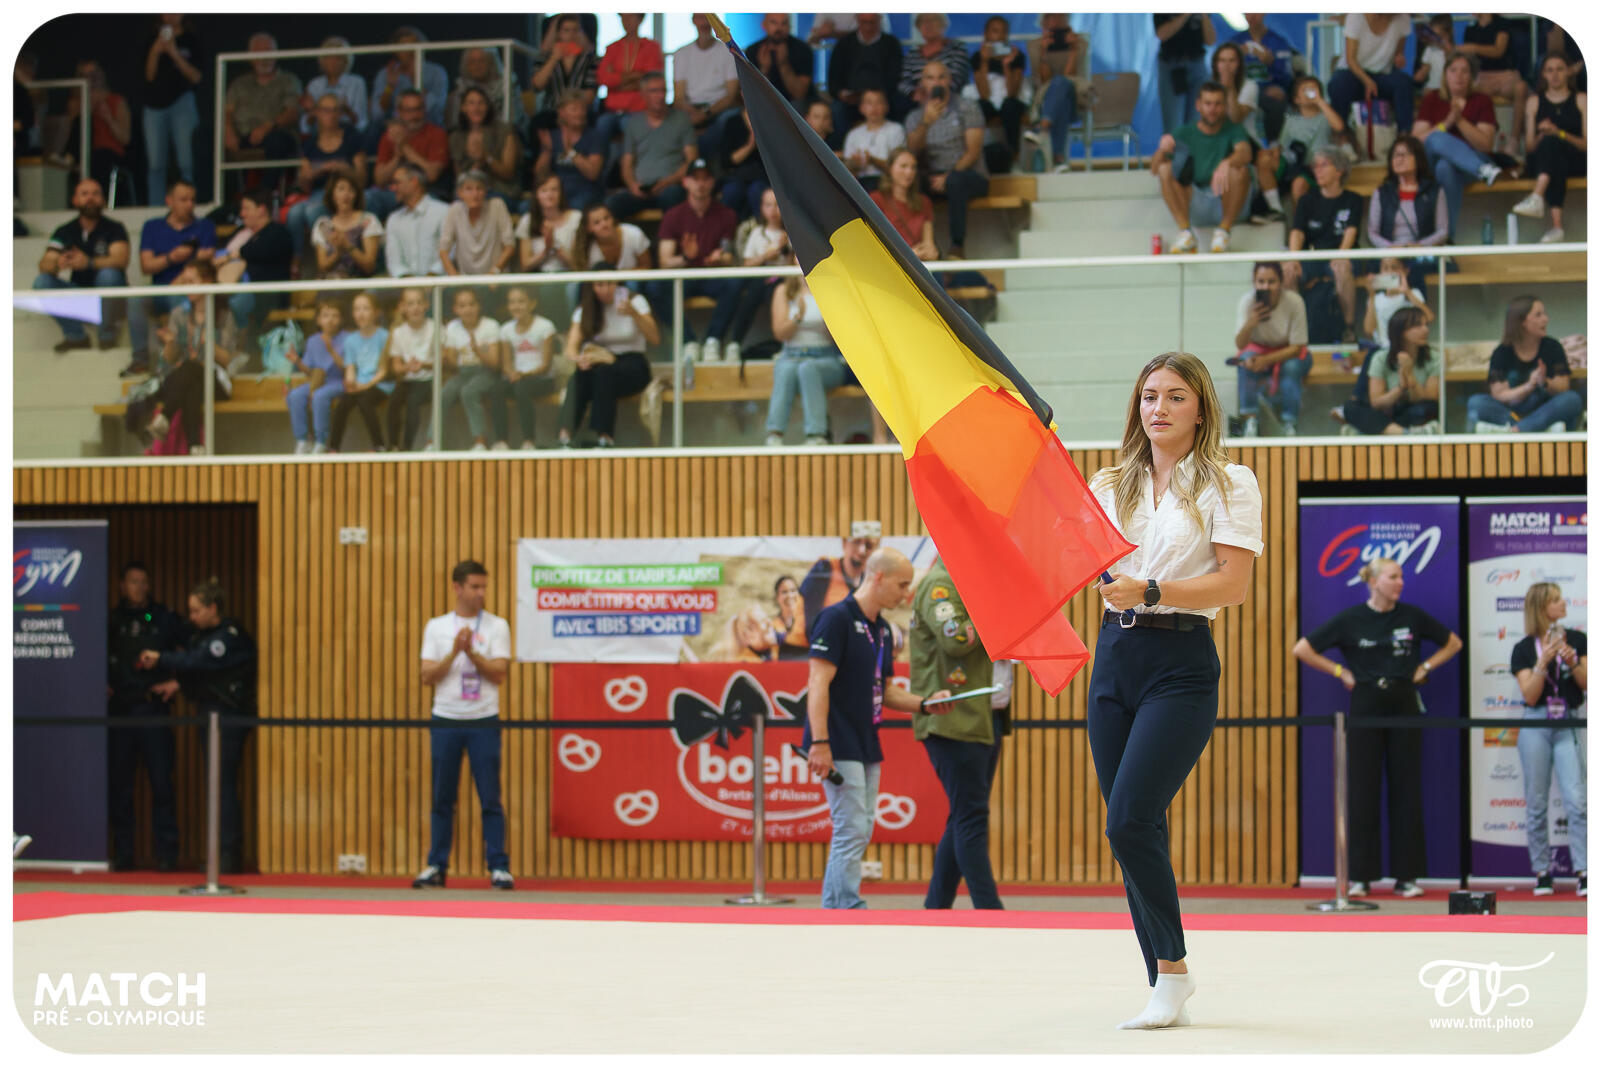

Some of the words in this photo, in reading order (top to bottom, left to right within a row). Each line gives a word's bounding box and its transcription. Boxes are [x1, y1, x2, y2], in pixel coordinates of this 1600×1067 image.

[1490, 512, 1551, 529] MATCH
[534, 569, 603, 585] PROFITEZ
[605, 568, 625, 584] DE
[628, 567, 675, 583] TARIFS
[676, 566, 720, 582] AUSSI
[540, 589, 634, 609] COMPÉTITIFS
[636, 594, 669, 611] QUE
[670, 594, 714, 610] VOUS
[21, 616, 63, 631] COMITÉ
[555, 618, 594, 634] AVEC
[596, 617, 628, 634] IBIS
[629, 616, 686, 633] SPORT
[688, 616, 697, 633] !
[13, 645, 52, 658] GRAND
[53, 645, 75, 658] EST
